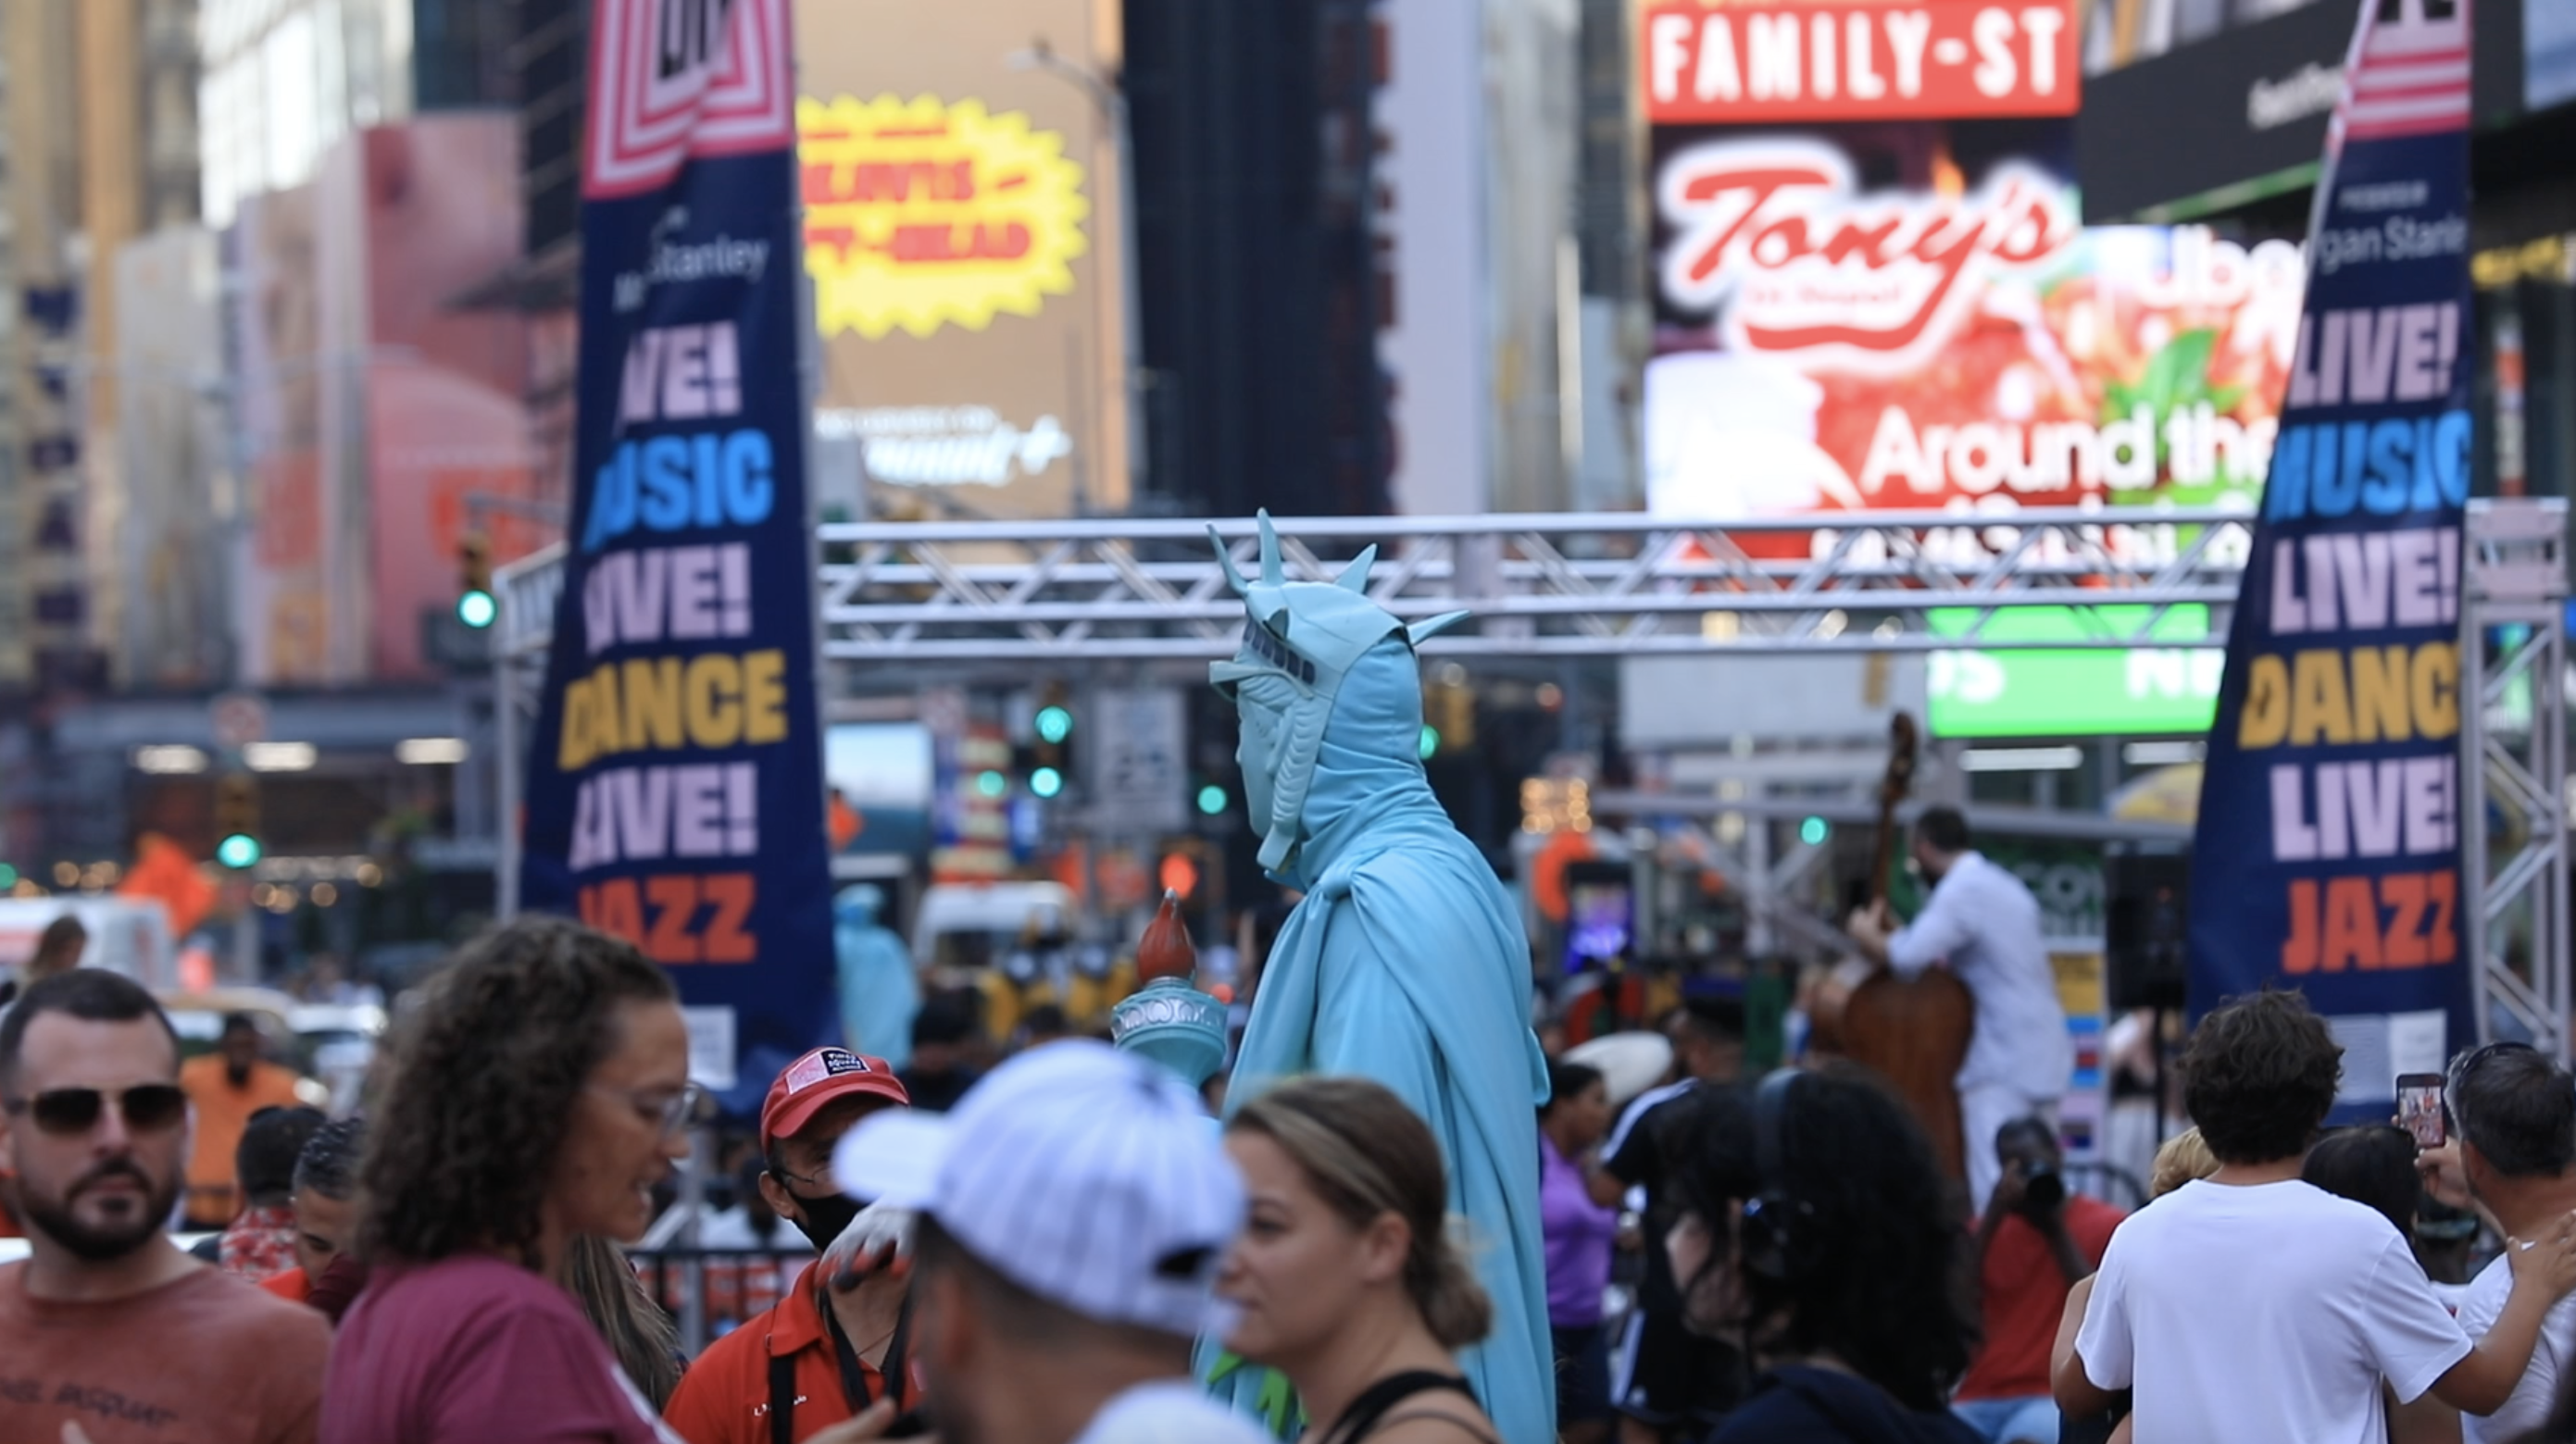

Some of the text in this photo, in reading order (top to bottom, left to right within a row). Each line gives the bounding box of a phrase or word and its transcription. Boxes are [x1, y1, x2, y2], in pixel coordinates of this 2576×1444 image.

[1651, 6, 2065, 104] FAMILY-ST
[1682, 168, 2079, 350] Tony's
[615, 322, 743, 437] VE!
[581, 429, 775, 553] USIC
[1859, 404, 2158, 494] Around
[2270, 527, 2459, 634] LIVE!
[557, 649, 787, 771] DANCE
[2237, 641, 2460, 749] DANC
[2282, 870, 2457, 974] JAZZ
